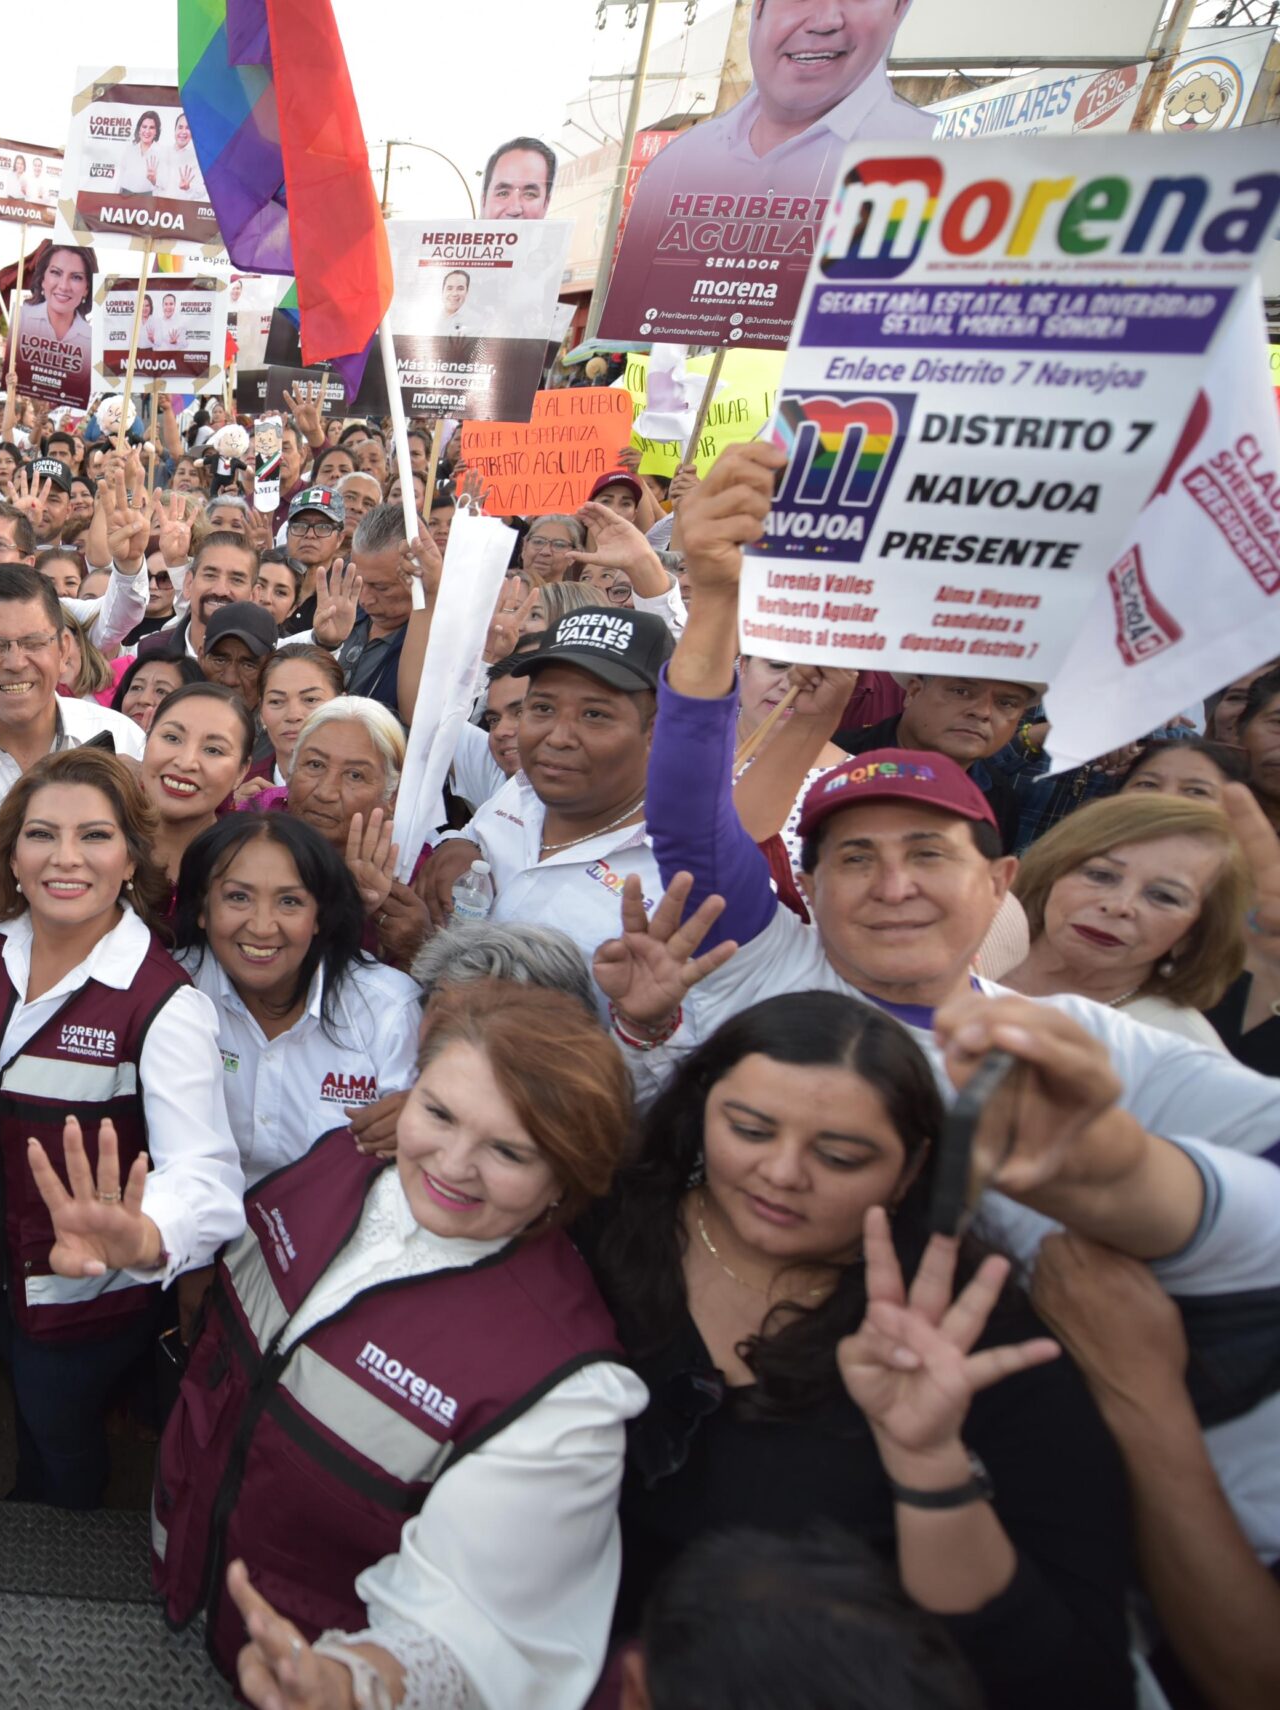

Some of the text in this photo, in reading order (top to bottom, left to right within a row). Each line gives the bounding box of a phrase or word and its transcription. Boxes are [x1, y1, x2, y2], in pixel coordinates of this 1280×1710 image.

[1086, 76, 1127, 114] 75%
[970, 76, 1076, 137] SIMILARES
[90, 116, 132, 127] LORENIA
[90, 125, 132, 138] VALLES
[90, 168, 114, 178] VOTA
[100, 207, 185, 230] NAVOJOA
[824, 158, 1280, 262] morena
[422, 232, 518, 246] HERIBERTO
[432, 246, 504, 260] AGUILAR
[706, 257, 780, 270] SENADOR
[692, 279, 778, 299] morena
[106, 306, 135, 314] VALLES
[700, 297, 733, 306] esperanza
[748, 298, 774, 307] México
[818, 288, 929, 315] SECRETARÍA
[931, 292, 1023, 315] ESTATAL
[1026, 292, 1059, 315] DE
[1056, 293, 1088, 316] LA
[658, 310, 727, 323] /Heriberto Aguilar
[880, 314, 955, 335] SEXUAL
[22, 334, 83, 358] LORENIA
[22, 347, 82, 372] VALLES
[30, 365, 67, 378] SENADORA
[32, 373, 62, 386] morena
[825, 356, 1147, 395] Enlace Distrito 7 Navojoa
[412, 392, 467, 406] morena
[545, 397, 566, 417] AL
[918, 413, 1155, 455] DISTRITO 7
[33, 460, 63, 470] LORENIA
[533, 448, 606, 475] AGUILAR
[905, 474, 1102, 515] NAVOJOA
[879, 530, 1082, 570] PRESENTE
[768, 570, 875, 596] Lorenia Valles
[934, 585, 1042, 610] Alma Higuera
[757, 596, 880, 623] Heriberto Aguilar
[558, 614, 634, 636] LORENIA
[743, 618, 888, 651] Candidatos al senado
[556, 626, 631, 650] VALLES
[562, 640, 607, 649] SENADORA
[900, 633, 967, 655] diputada
[968, 638, 1026, 659] distrito
[61, 1034, 115, 1052] VALLES
[62, 1024, 117, 1041] LORENIA
[68, 1046, 102, 1058] SENADORA
[322, 1072, 378, 1090] ALMA
[320, 1086, 378, 1101] HIGUERA
[359, 1341, 458, 1420] morena
[356, 1357, 452, 1428] La esperanza de México
